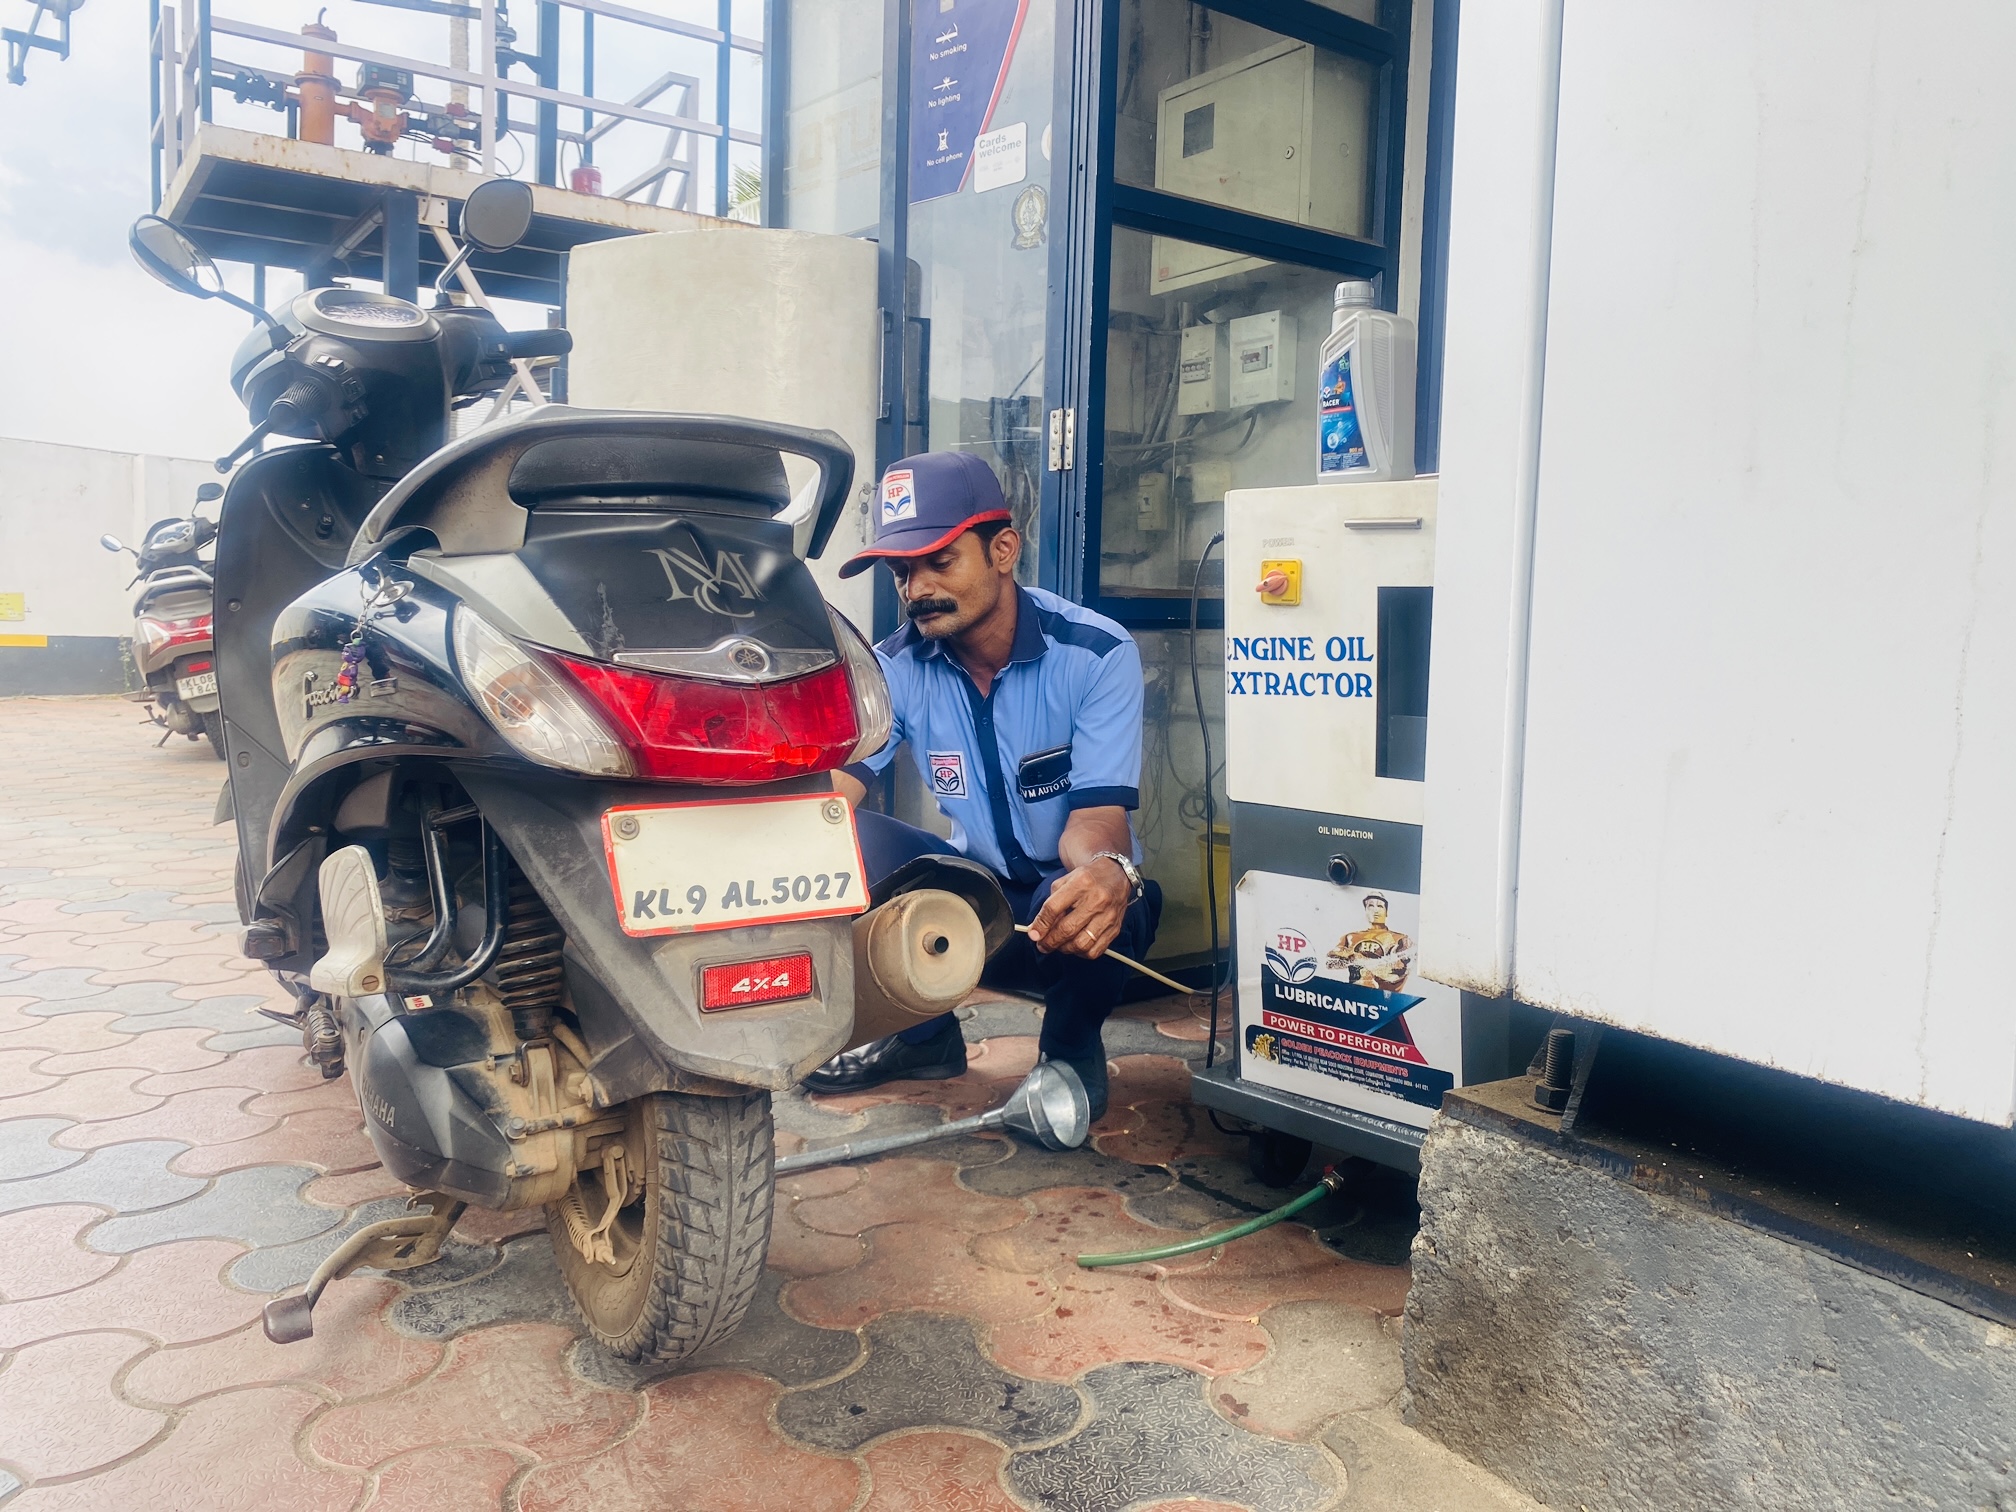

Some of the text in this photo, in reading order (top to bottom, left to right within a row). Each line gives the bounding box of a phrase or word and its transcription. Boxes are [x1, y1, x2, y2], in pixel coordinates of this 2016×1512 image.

[929, 43, 967, 61] No smoking
[928, 93, 961, 108] No lighting
[979, 134, 1007, 149] Cards
[979, 139, 1022, 159] welcome
[926, 152, 963, 167] No cell phone
[1322, 399, 1340, 408] RACER
[888, 486, 904, 499] HP
[1262, 537, 1294, 548] POWER
[1325, 636, 1374, 662] OIL
[1227, 671, 1373, 698] XTRACTOR
[939, 770, 953, 778] HP
[1038, 783, 1060, 796] AUTO
[1318, 826, 1373, 840] OIL INDICATION
[721, 872, 852, 910] AL.5027
[1277, 934, 1307, 953] HP
[1360, 941, 1381, 953] HP
[1270, 1015, 1315, 1036] POWER
[1318, 1027, 1335, 1041] TO
[1281, 1037, 1313, 1054] GOLDEN
[1314, 1046, 1352, 1063] PEACOCK
[1353, 1056, 1408, 1077] EQUIPMENTS
